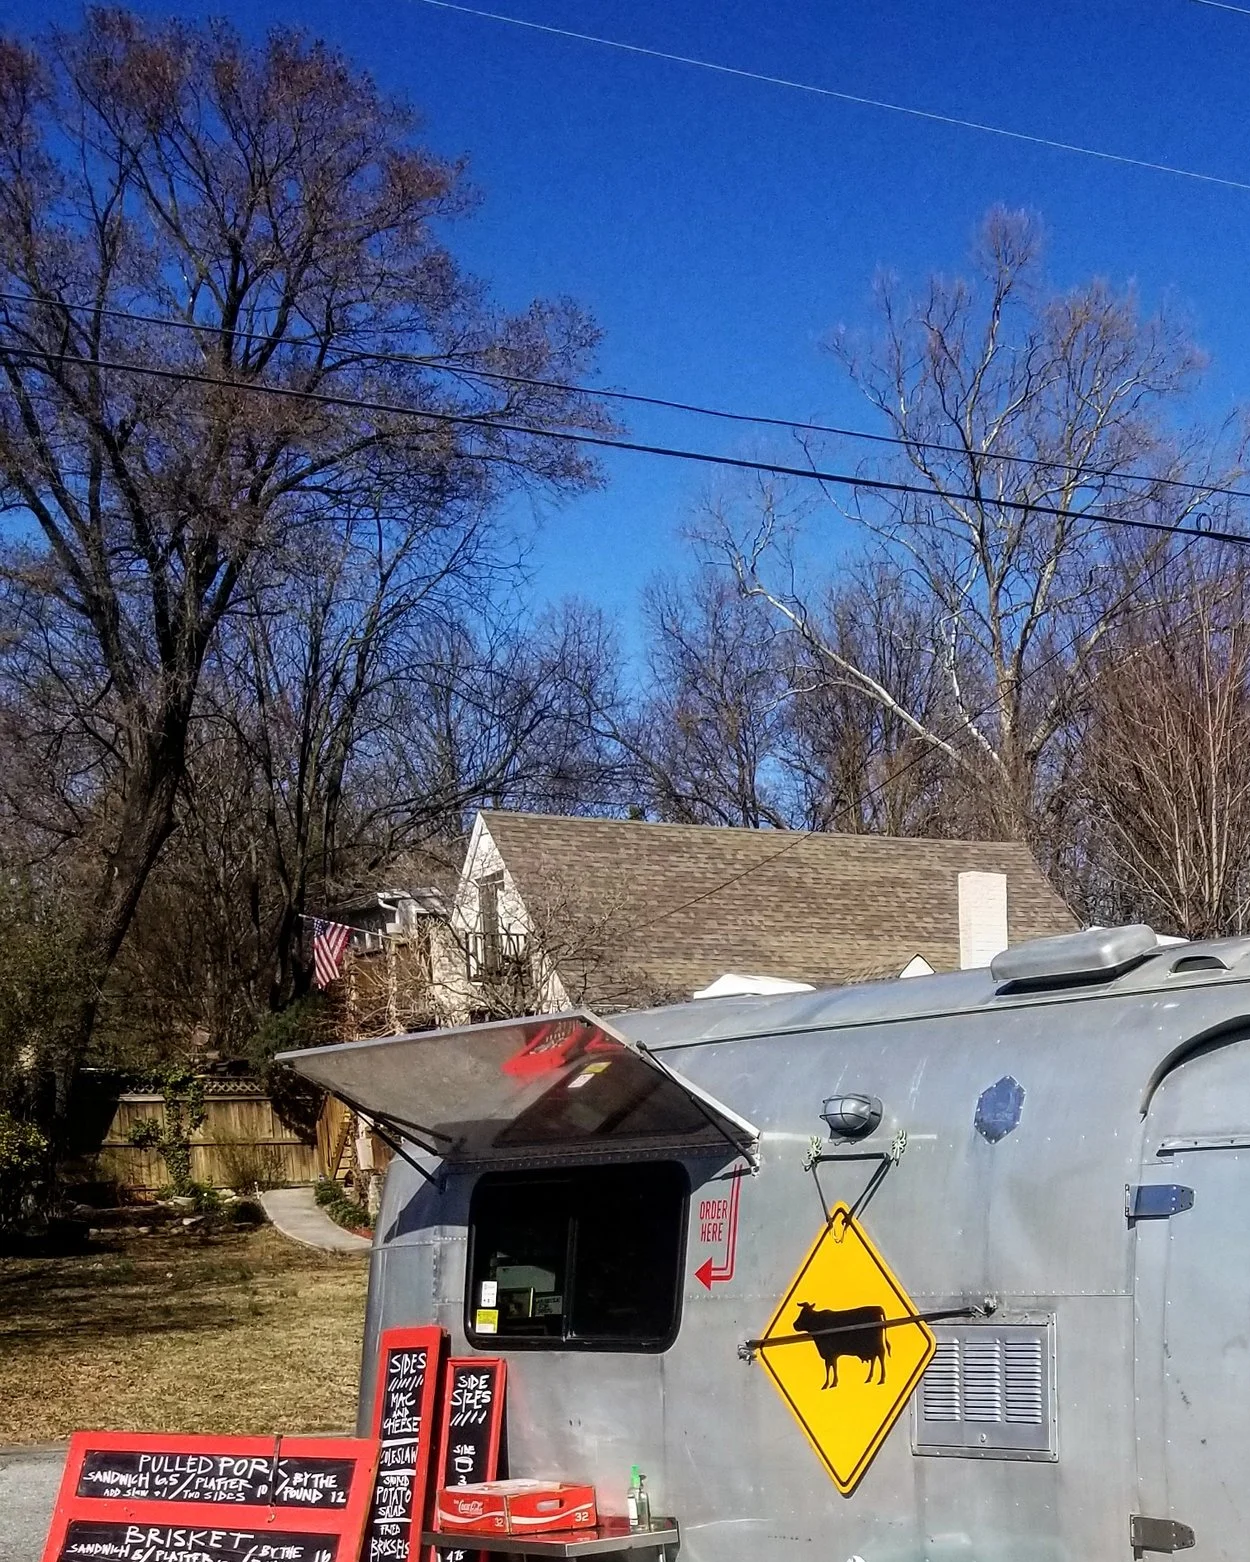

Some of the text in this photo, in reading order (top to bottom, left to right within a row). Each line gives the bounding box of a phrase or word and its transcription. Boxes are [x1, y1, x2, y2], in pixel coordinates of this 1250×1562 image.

[700, 1200, 728, 1220] ORDER
[700, 1222, 724, 1242] HERE
[390, 1353, 427, 1377] SIDES
[458, 1375, 490, 1390] SIDE
[390, 1392, 416, 1408] MAC
[450, 1390, 492, 1413] SIZES
[392, 1408, 410, 1419] AND
[383, 1416, 422, 1435] CHEESE
[453, 1445, 476, 1456] SIDE
[139, 1454, 289, 1481] PULLED PORK
[83, 1470, 150, 1489] SANDWICH
[195, 1477, 253, 1491] PLATTER
[458, 1475, 467, 1486] 3
[103, 1488, 121, 1497] ADD
[183, 1489, 246, 1502] TWO SIDES
[257, 1485, 269, 1498] 10
[283, 1487, 347, 1503] POUND 12
[376, 1487, 412, 1506] POTATO
[494, 1516, 504, 1527] 32
[574, 1511, 590, 1523] 32
[125, 1525, 255, 1551] BRISKET
[66, 1543, 131, 1559] SANDWICH
[260, 1545, 279, 1559] BY
[279, 1545, 305, 1559] THE
